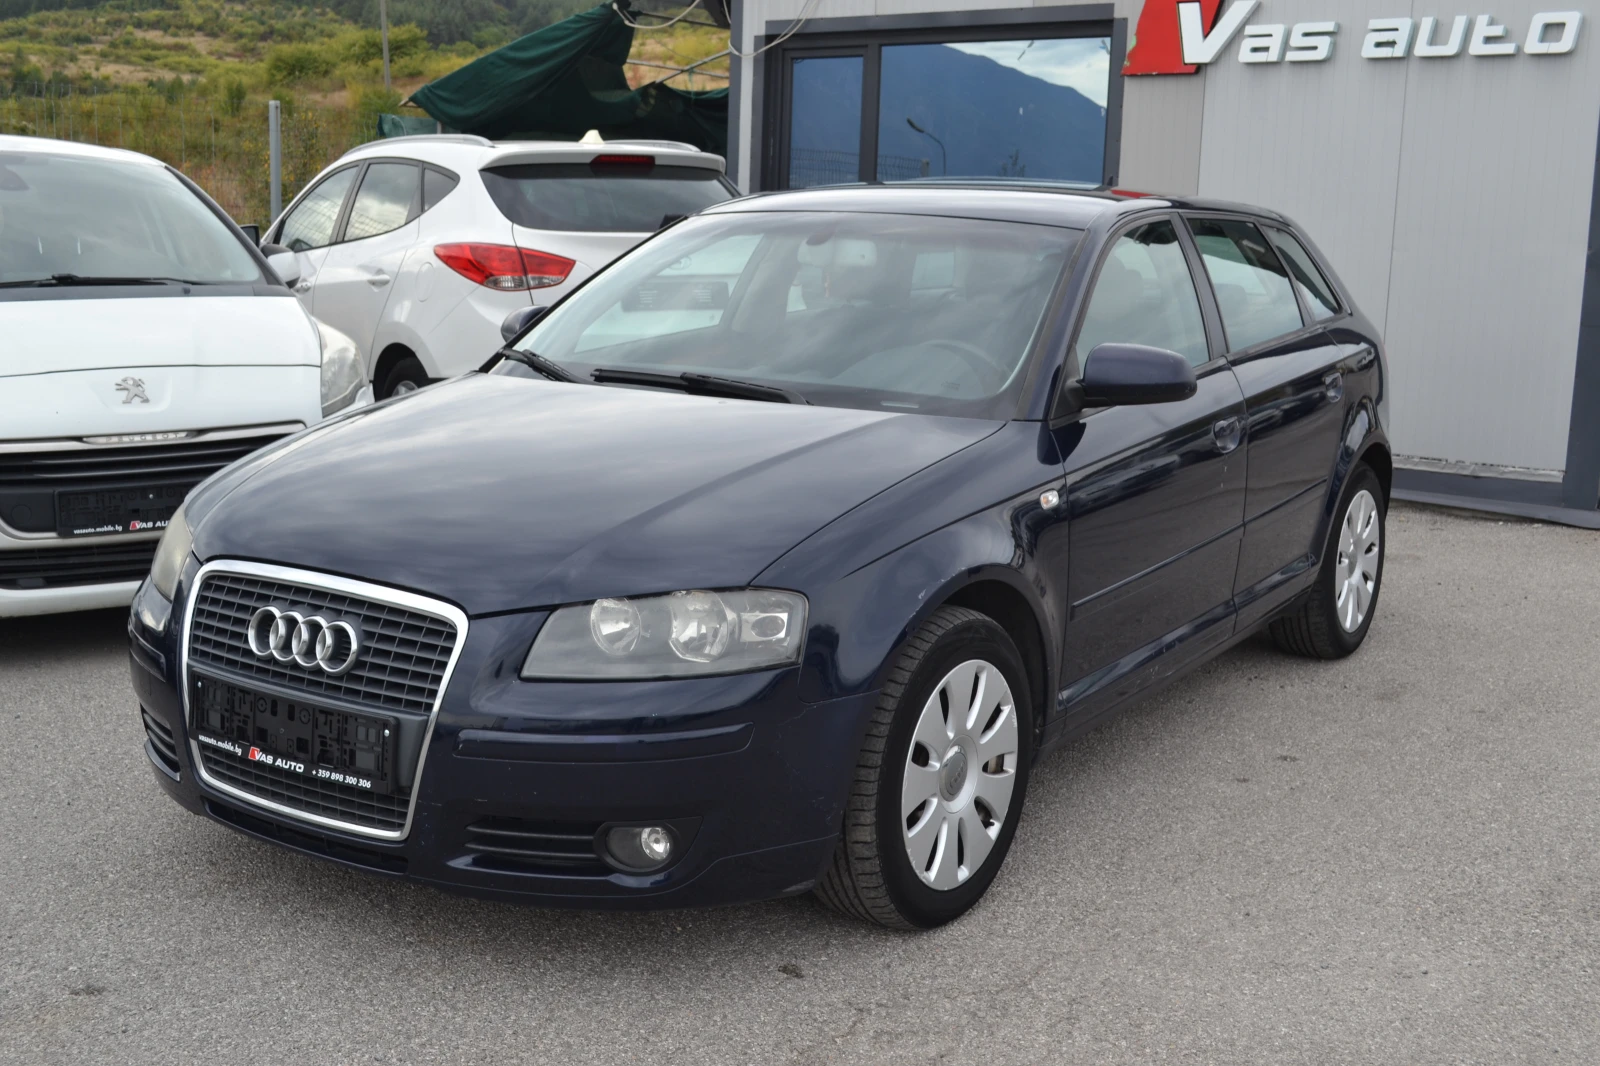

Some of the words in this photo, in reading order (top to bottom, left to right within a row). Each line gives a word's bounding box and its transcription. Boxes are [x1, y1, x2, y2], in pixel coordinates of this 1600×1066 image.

[1175, 0, 1339, 65] Vas
[1361, 11, 1583, 60] auto
[106, 431, 180, 443] PEUGEOT
[73, 525, 123, 534] vasauto.mobile.bg
[135, 521, 153, 529] VAS
[155, 520, 170, 528] AU
[199, 735, 242, 756] vasauto.mobile.bg
[254, 750, 273, 764] VAS
[275, 758, 305, 773] AUTO
[317, 768, 331, 779] 359
[330, 772, 344, 782] 898
[344, 775, 358, 786] 300
[357, 778, 371, 788] 306
